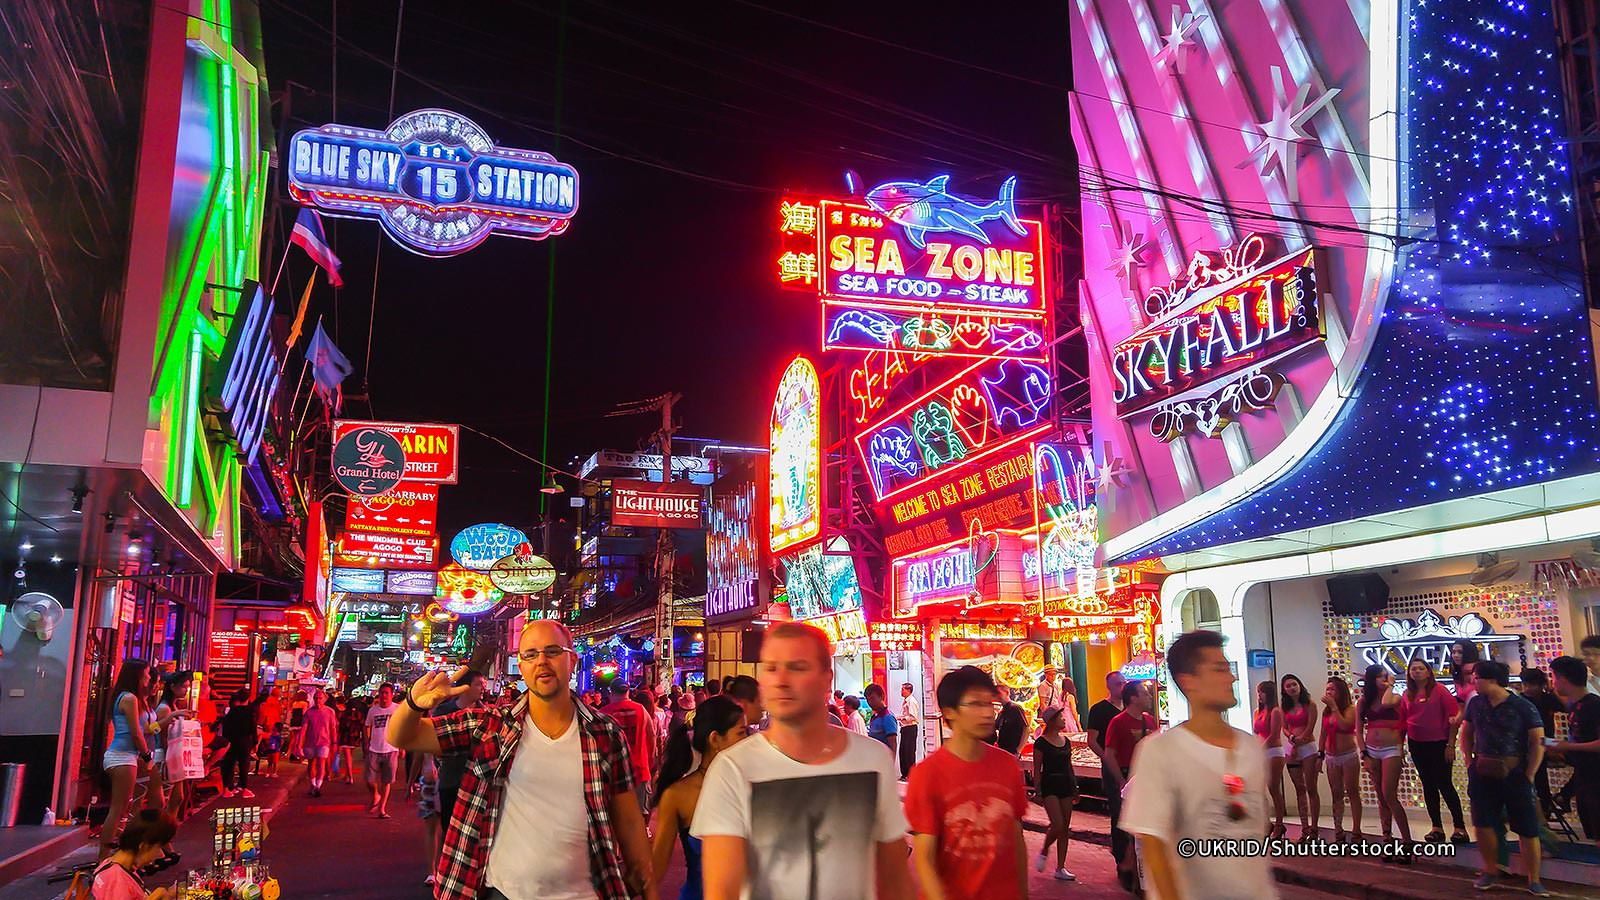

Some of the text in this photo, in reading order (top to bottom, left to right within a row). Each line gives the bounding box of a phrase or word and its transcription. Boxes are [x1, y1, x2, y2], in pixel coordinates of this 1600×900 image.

[295, 141, 574, 208] BLUE SKY STATION
[416, 166, 457, 198] 15
[778, 201, 818, 285] 海鲜
[830, 235, 1035, 286] SEA ZONE
[838, 273, 1029, 304] SEA FOOD STEAK
[1112, 279, 1294, 403] SKYFALL
[401, 434, 448, 455] ARIN
[337, 465, 400, 481] Grand Hotel
[405, 461, 439, 473] STREET
[386, 490, 436, 502] GARBABY
[892, 494, 929, 523] WELCOME
[926, 489, 941, 511] TO
[941, 483, 961, 506] SEA
[959, 473, 987, 500] ZONE
[985, 452, 1049, 491] RESTAURAT
[616, 495, 699, 512] LIGHTHOUSE
[350, 533, 366, 541] THE
[367, 535, 405, 545] WINDMILL
[373, 543, 403, 552] AGOGO
[339, 600, 422, 614] ALCATAZ
[705, 580, 755, 617] LIGHTHOUSE
[1362, 641, 1492, 676] SKYFA
